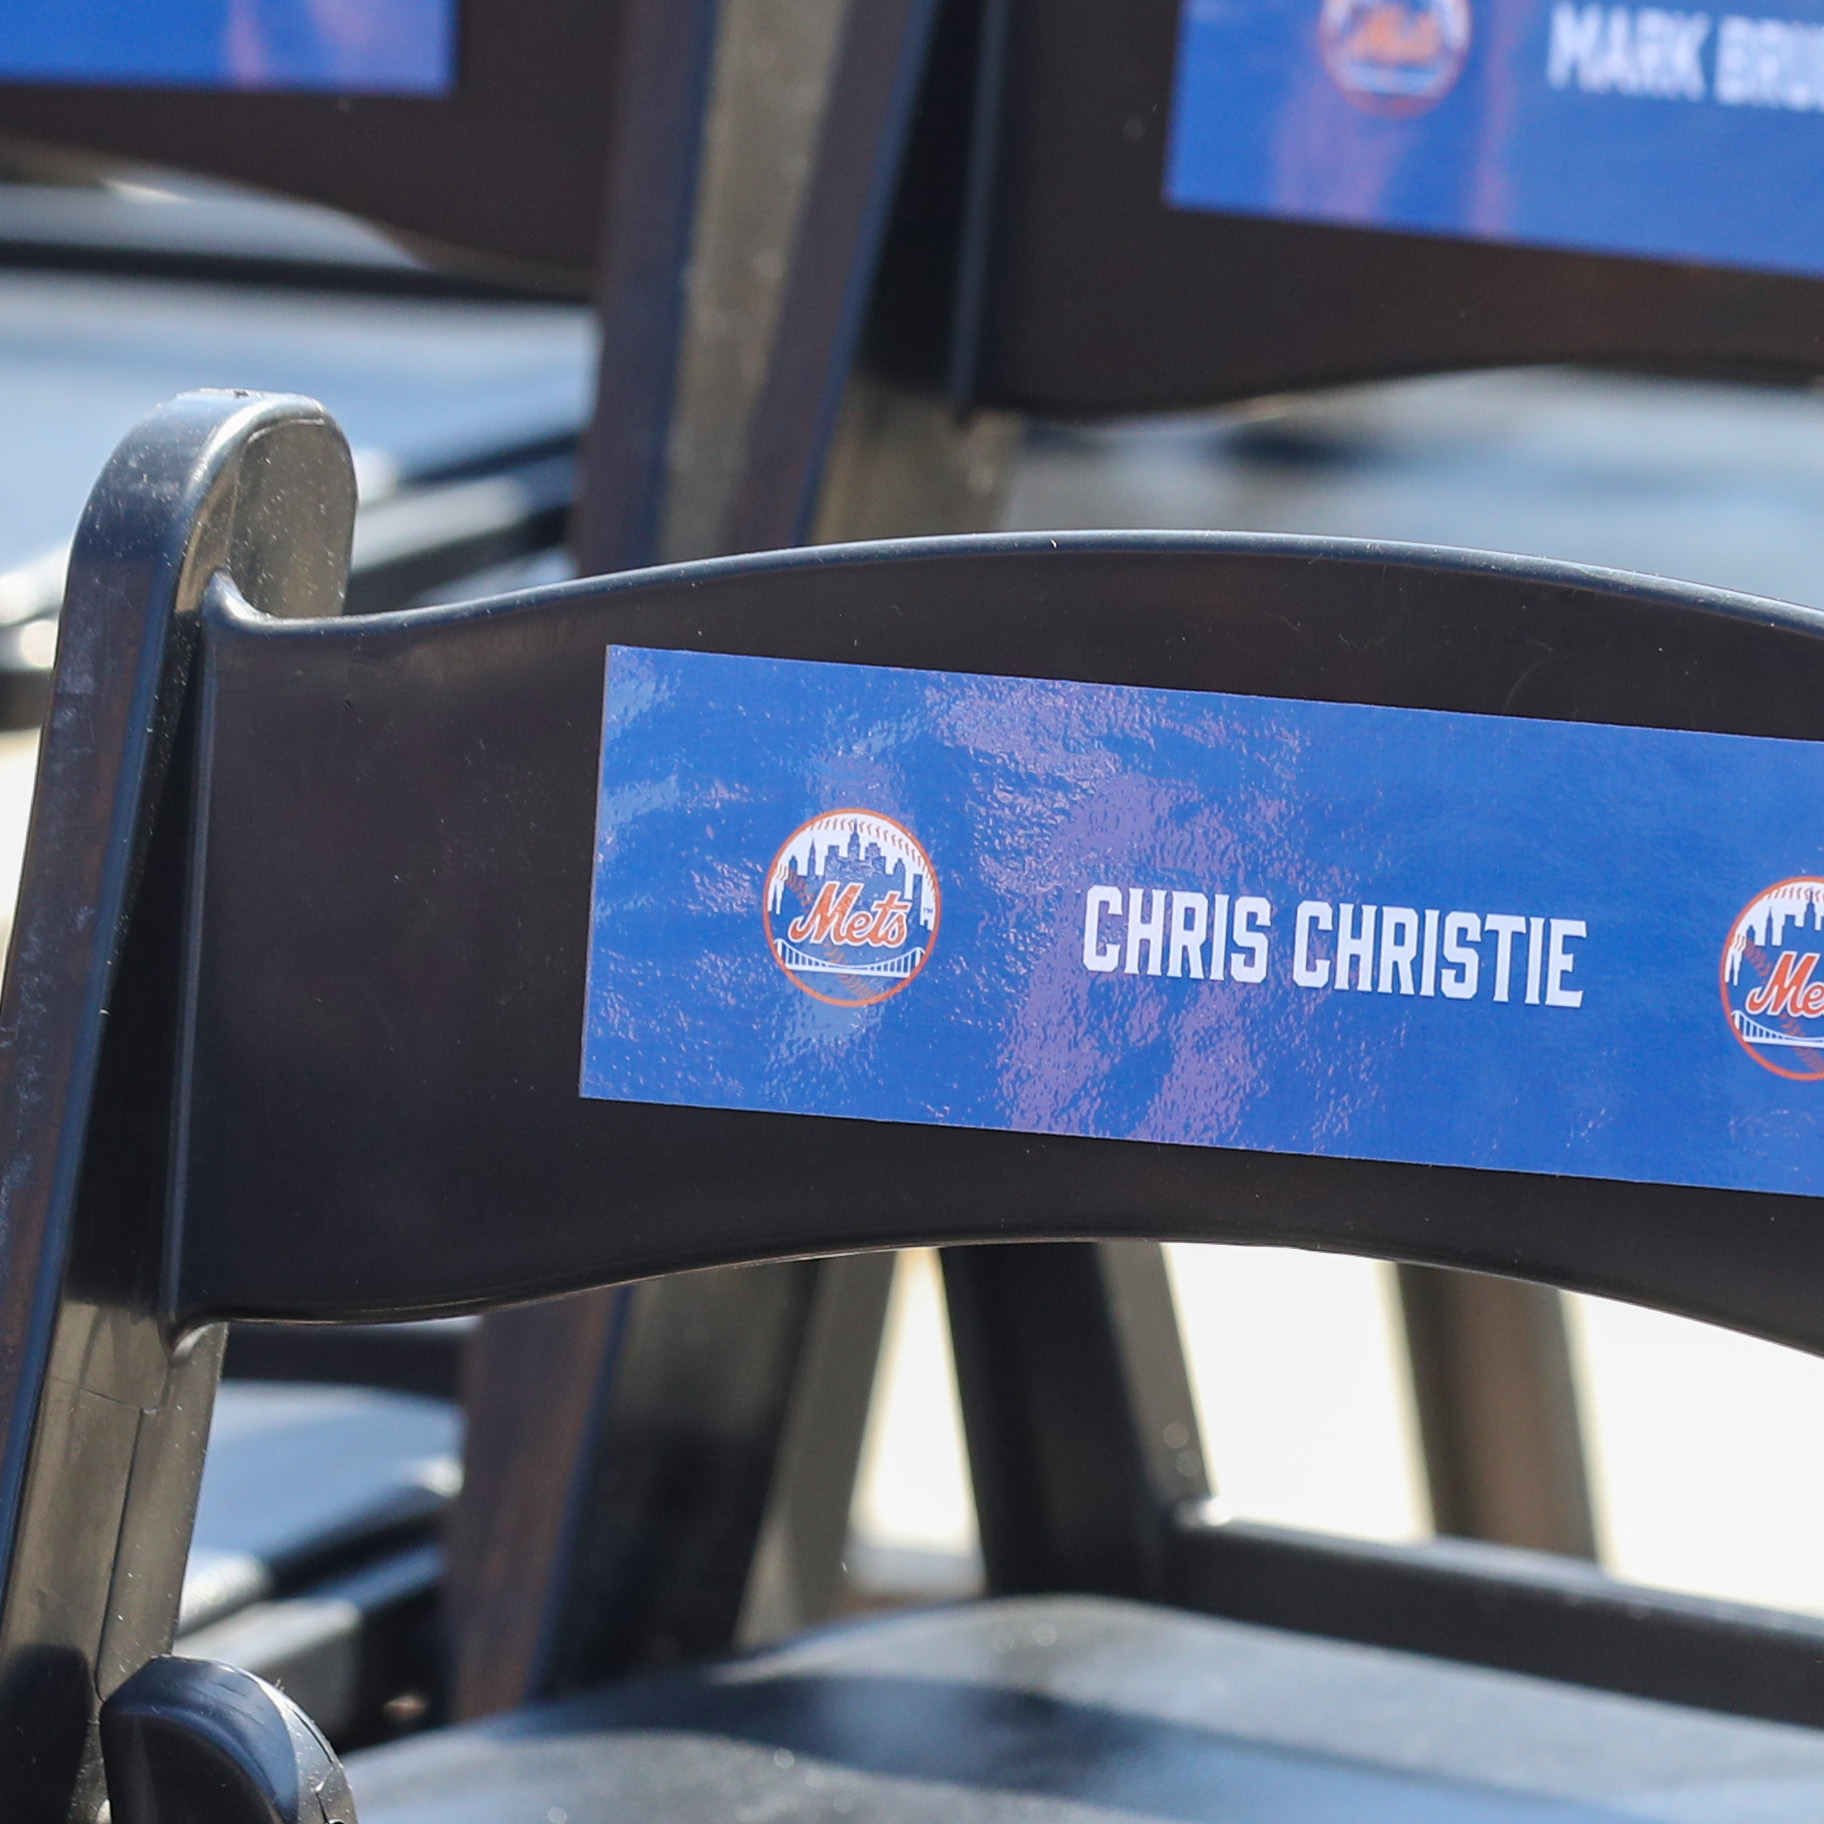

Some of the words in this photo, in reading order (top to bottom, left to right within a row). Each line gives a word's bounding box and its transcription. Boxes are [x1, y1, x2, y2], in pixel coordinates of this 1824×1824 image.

[1547, 0, 1710, 102] MARK
[788, 880, 914, 949] Mets
[1083, 884, 1270, 985] CHRIS
[1290, 899, 1588, 1011] CHRISTIE
